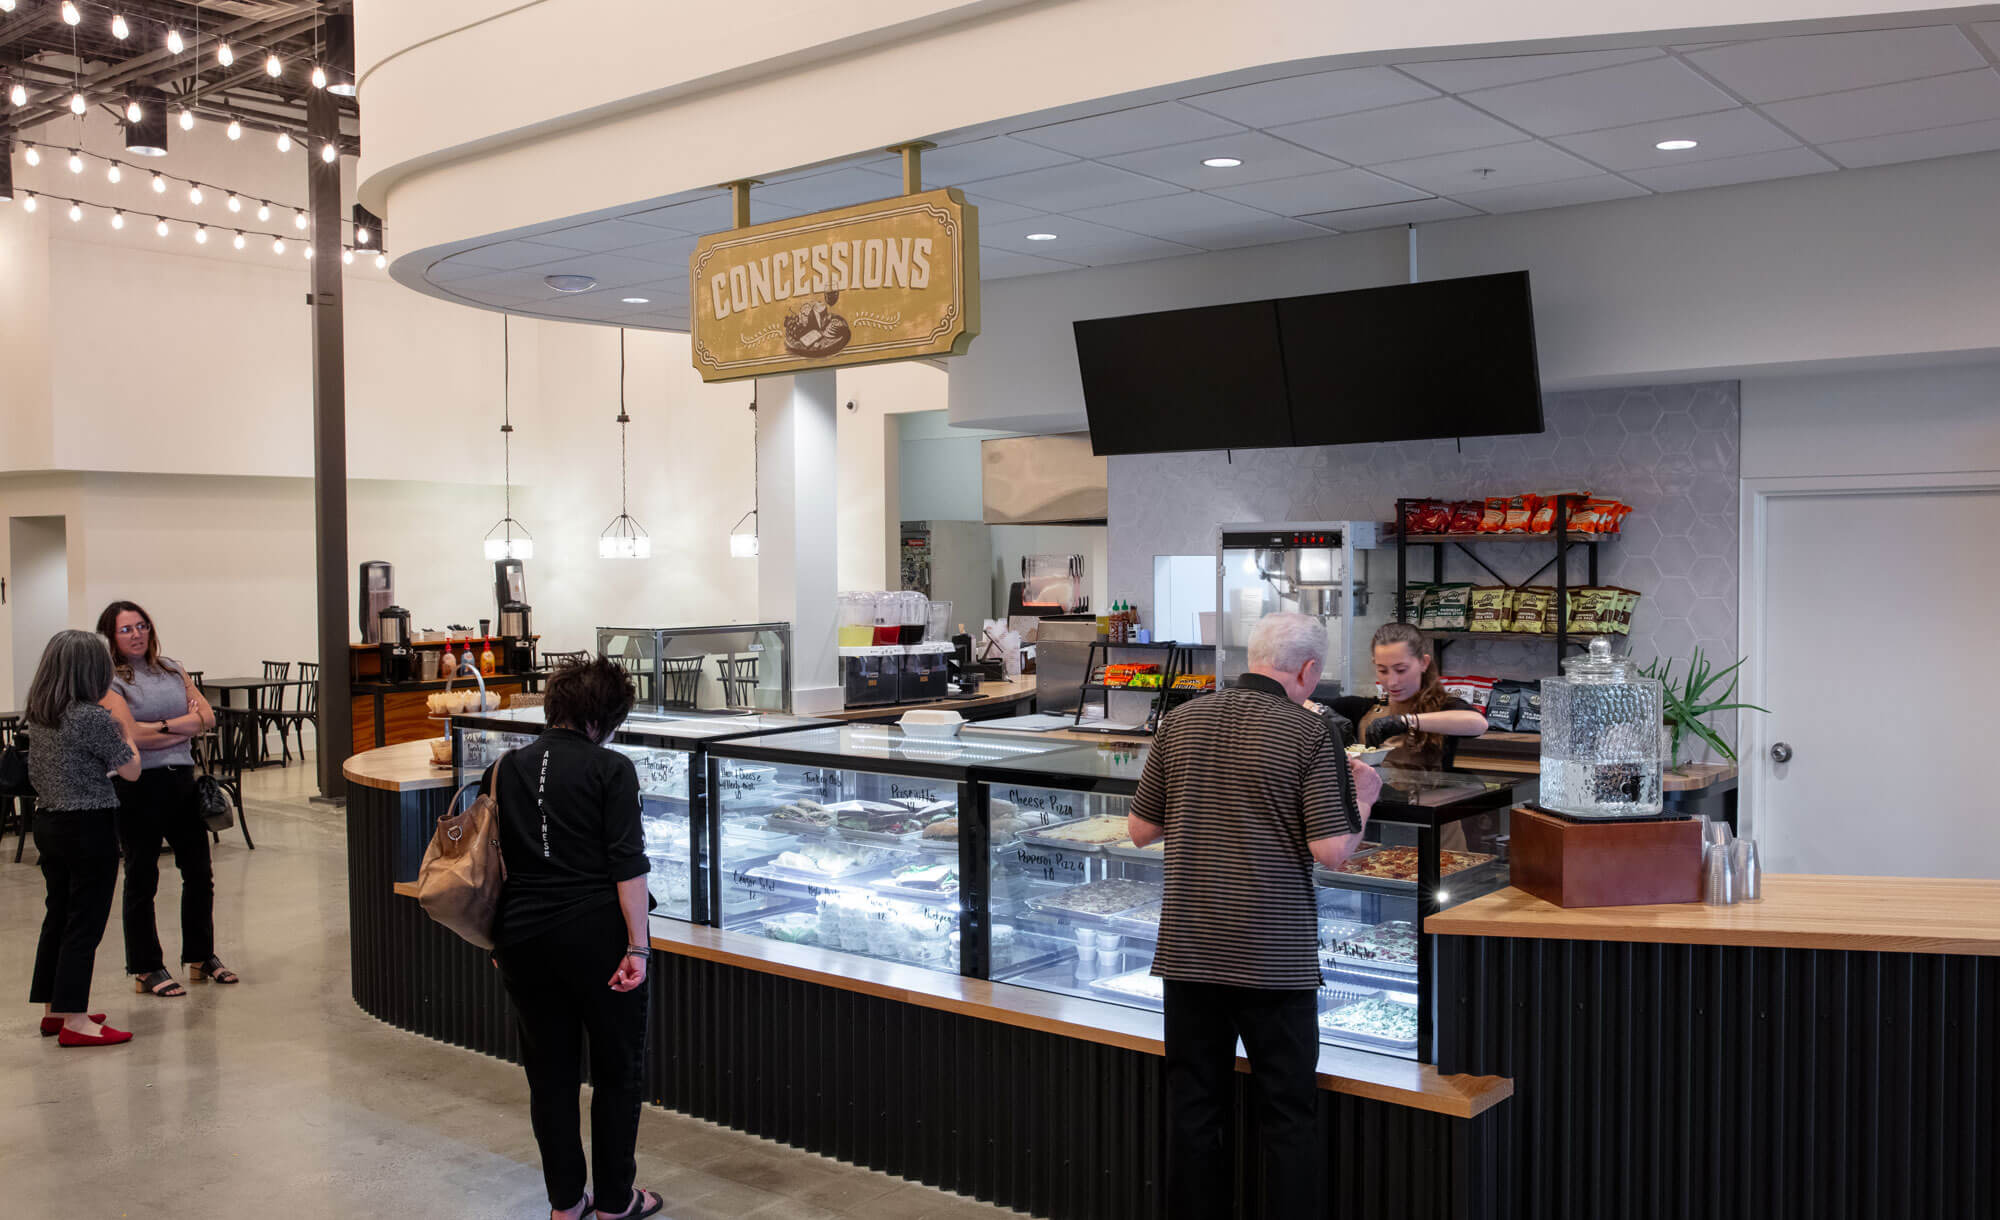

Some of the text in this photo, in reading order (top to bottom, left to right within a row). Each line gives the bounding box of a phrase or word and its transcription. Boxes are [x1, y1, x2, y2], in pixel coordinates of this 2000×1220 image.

[710, 237, 933, 321] CONCESSIONS
[537, 750, 551, 857] ARENA FTNESS
[1009, 789, 1073, 816] Cheese Pizza
[1040, 811, 1049, 825] 10
[1056, 852, 1085, 872] Pizza
[1043, 867, 1055, 881] 10
